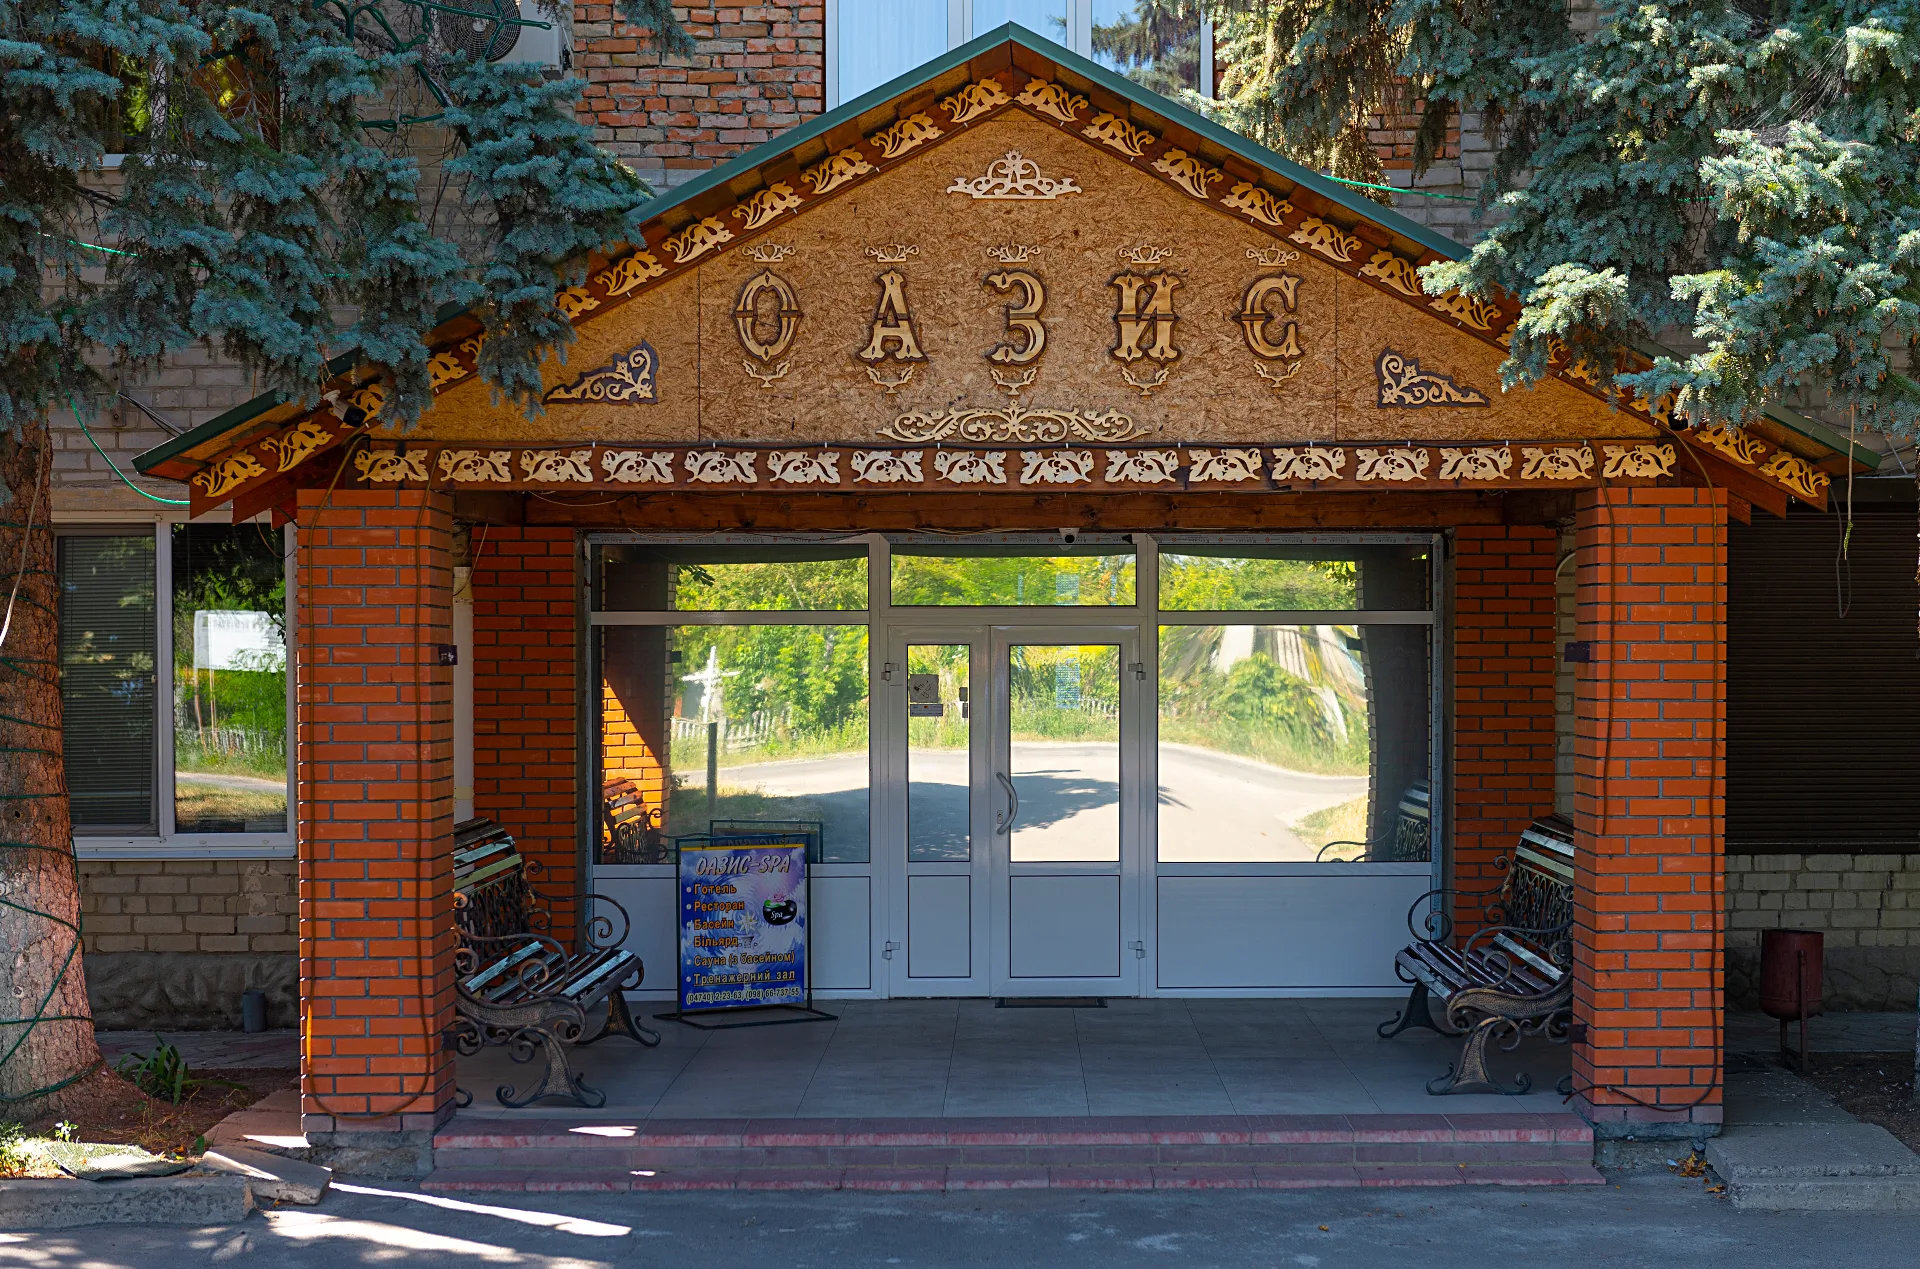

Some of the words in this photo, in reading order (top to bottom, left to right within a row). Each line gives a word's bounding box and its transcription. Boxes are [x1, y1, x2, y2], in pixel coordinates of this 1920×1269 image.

[732, 268, 1304, 365] ОАЗИС
[695, 855, 791, 875] ОАЗИС-SPA
[694, 883, 737, 895] Готель
[694, 901, 745, 913] Ресторан
[694, 918, 735, 930] Басейн
[694, 936, 739, 948] Більярд
[694, 955, 726, 969] Сауна
[741, 949, 795, 964] басейном)
[694, 969, 770, 986] Тренажерний
[776, 970, 795, 981] зал
